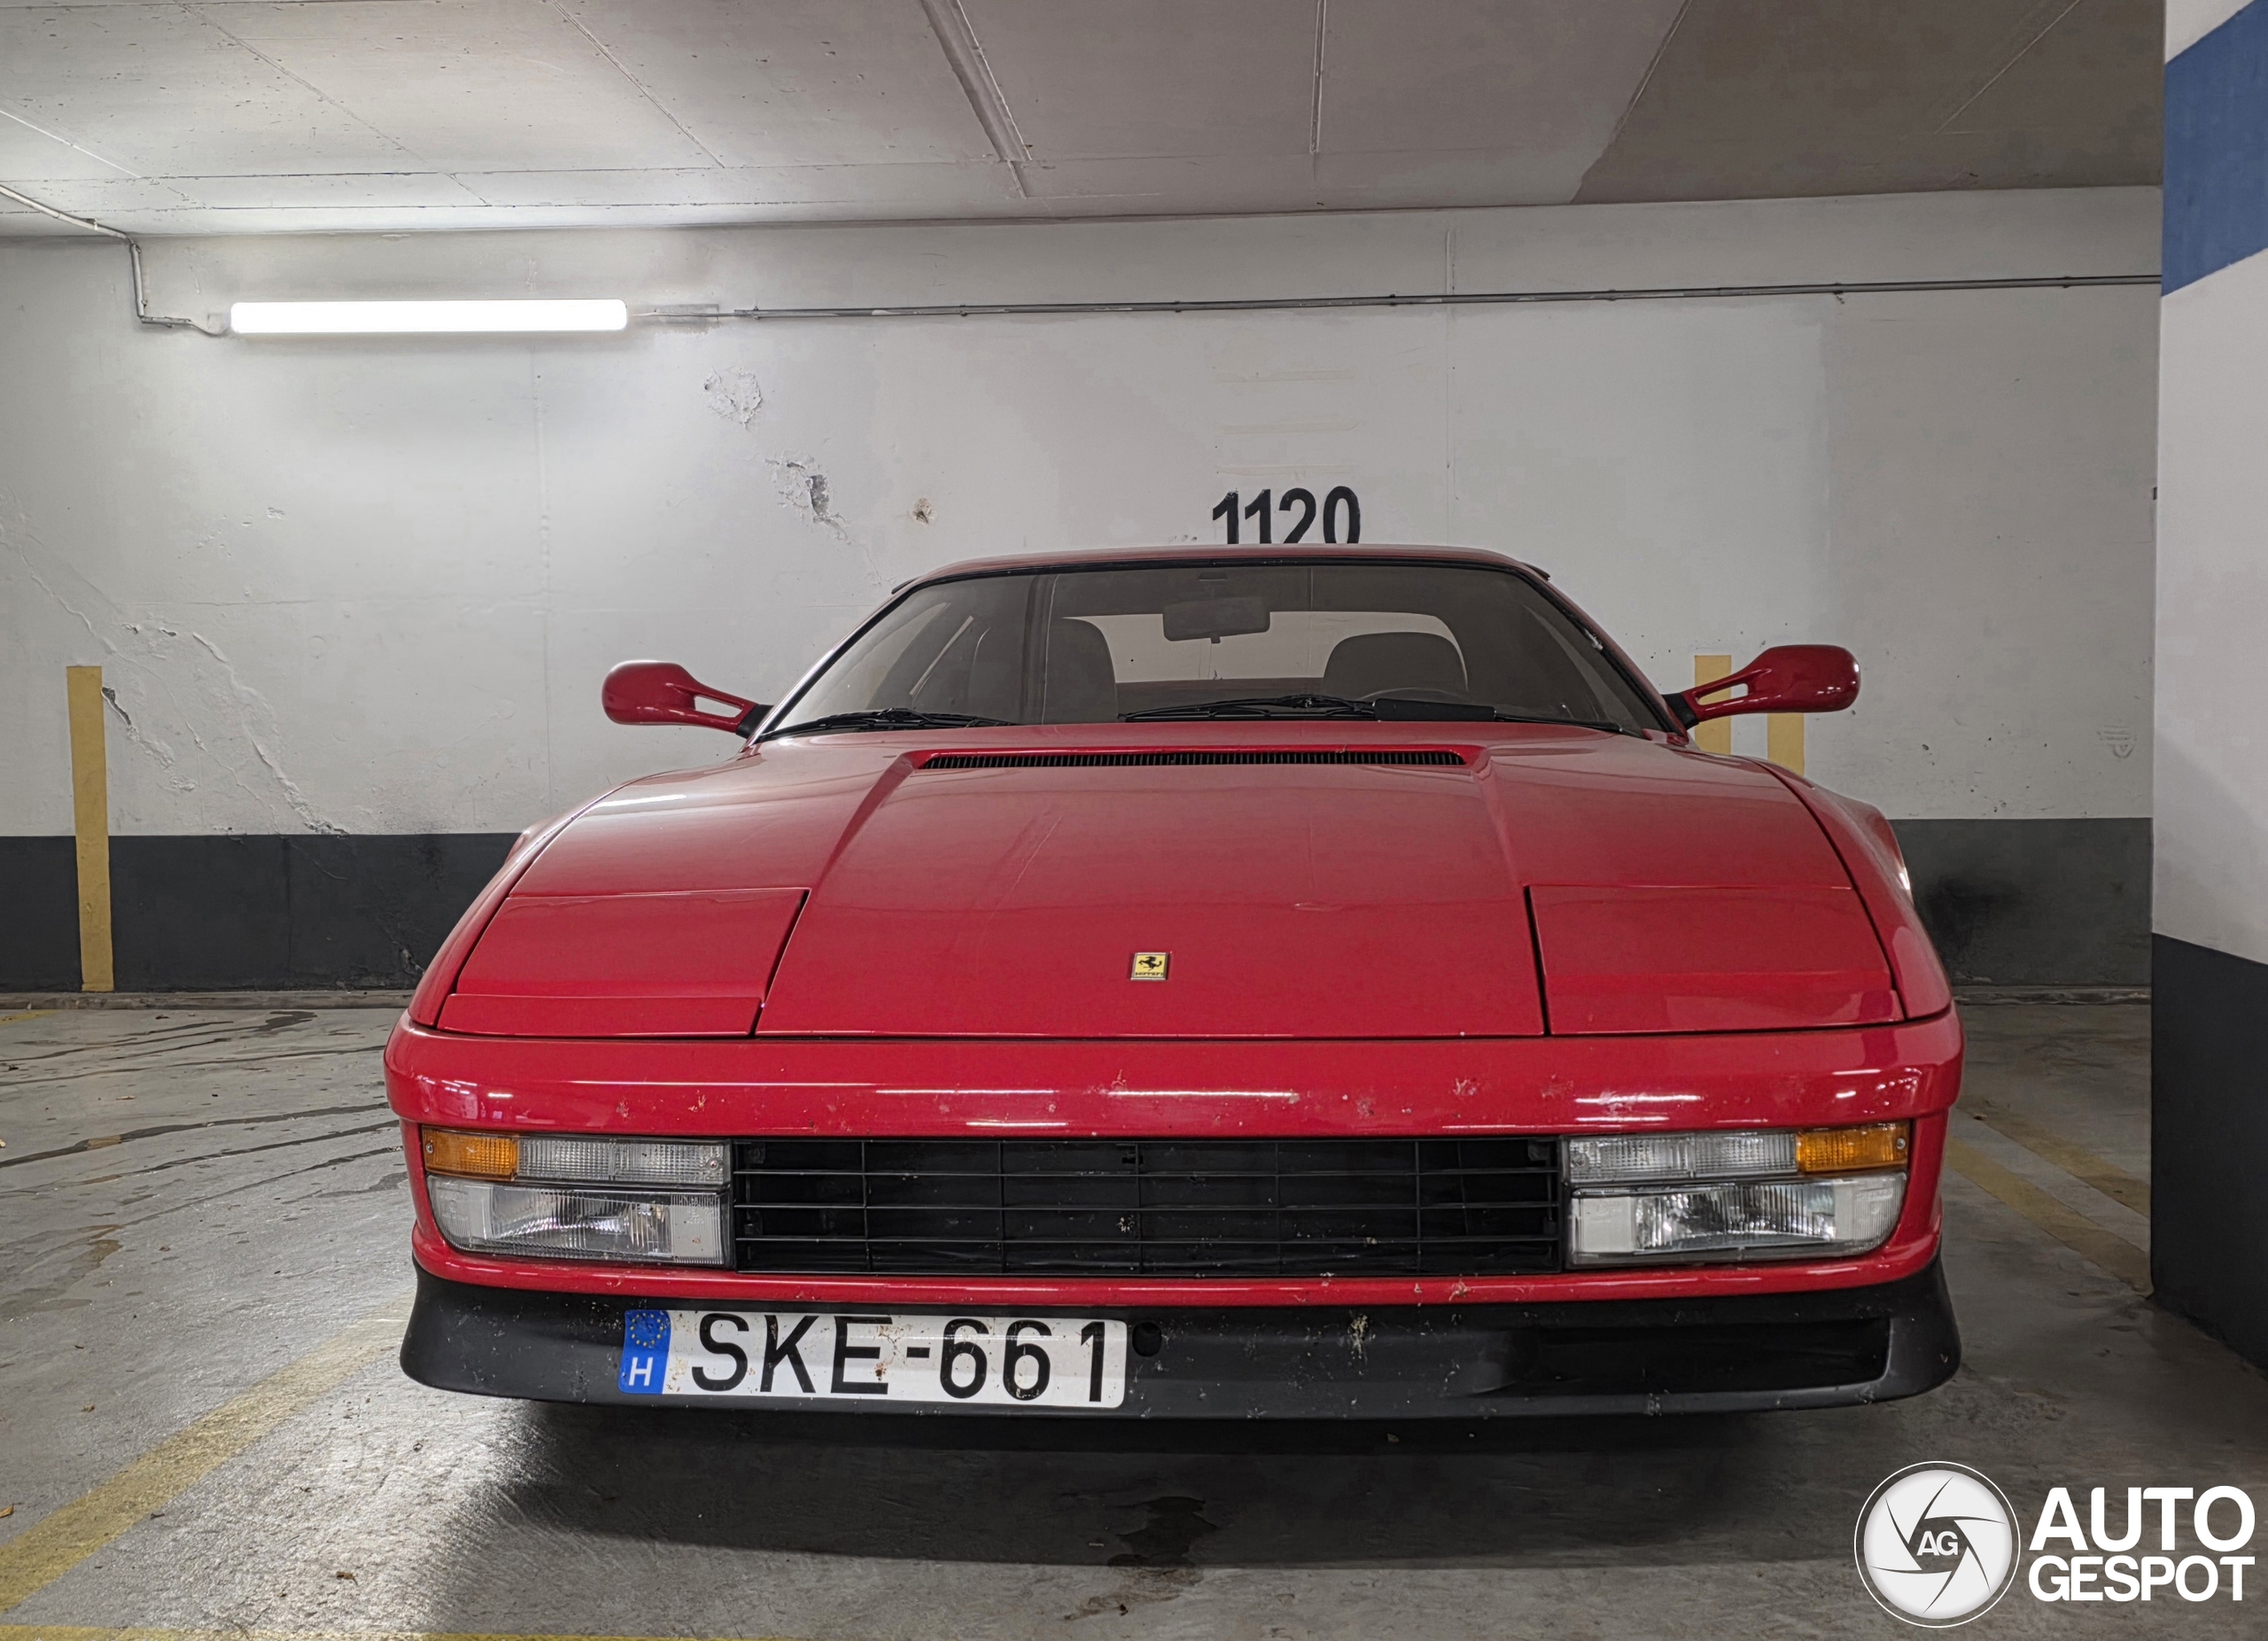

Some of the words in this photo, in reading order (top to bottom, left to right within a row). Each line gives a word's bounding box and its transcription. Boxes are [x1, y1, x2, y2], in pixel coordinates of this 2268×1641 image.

[1213, 486, 1361, 544] 1120
[628, 1357, 653, 1387] H
[692, 1313, 1104, 1403] SKE-661
